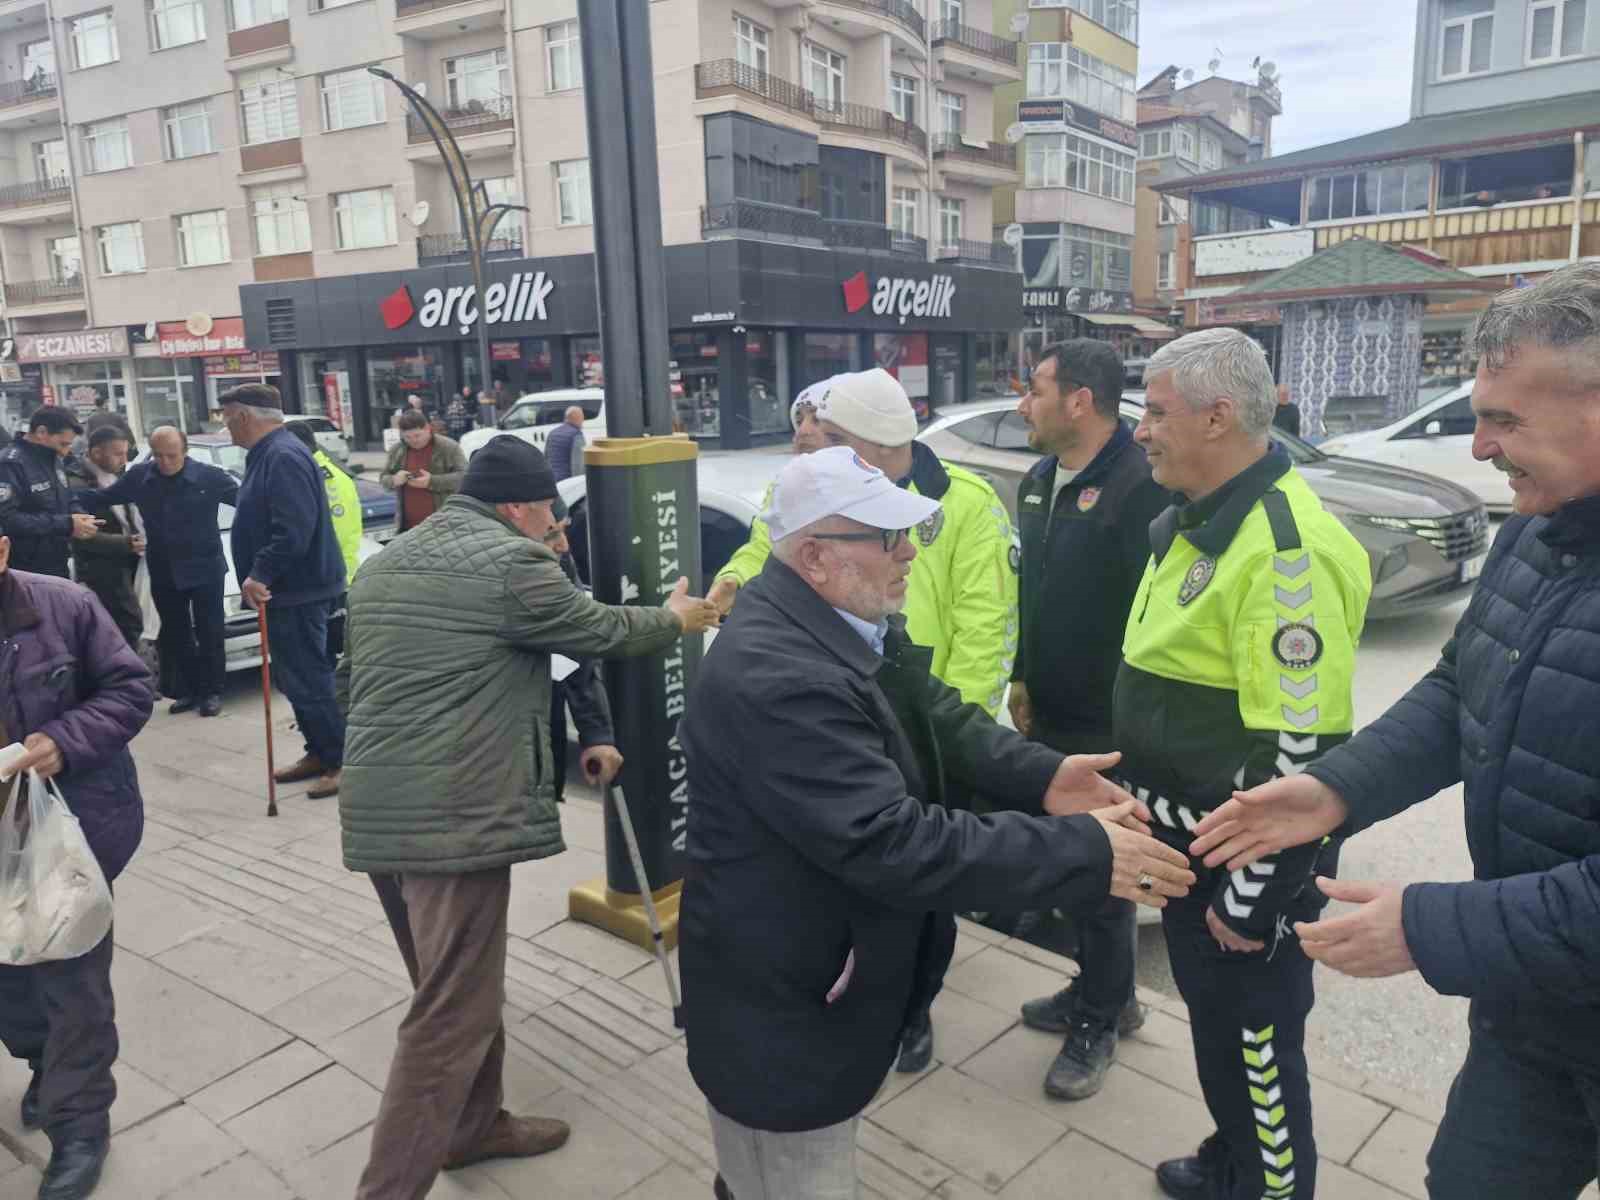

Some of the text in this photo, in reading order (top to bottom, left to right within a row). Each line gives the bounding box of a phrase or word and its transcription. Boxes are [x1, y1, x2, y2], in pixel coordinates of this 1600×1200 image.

[419, 271, 554, 335] arçelik
[872, 274, 956, 325] arçelik
[36, 333, 112, 357] ECZANESİ
[651, 489, 686, 719] BELİYESİ
